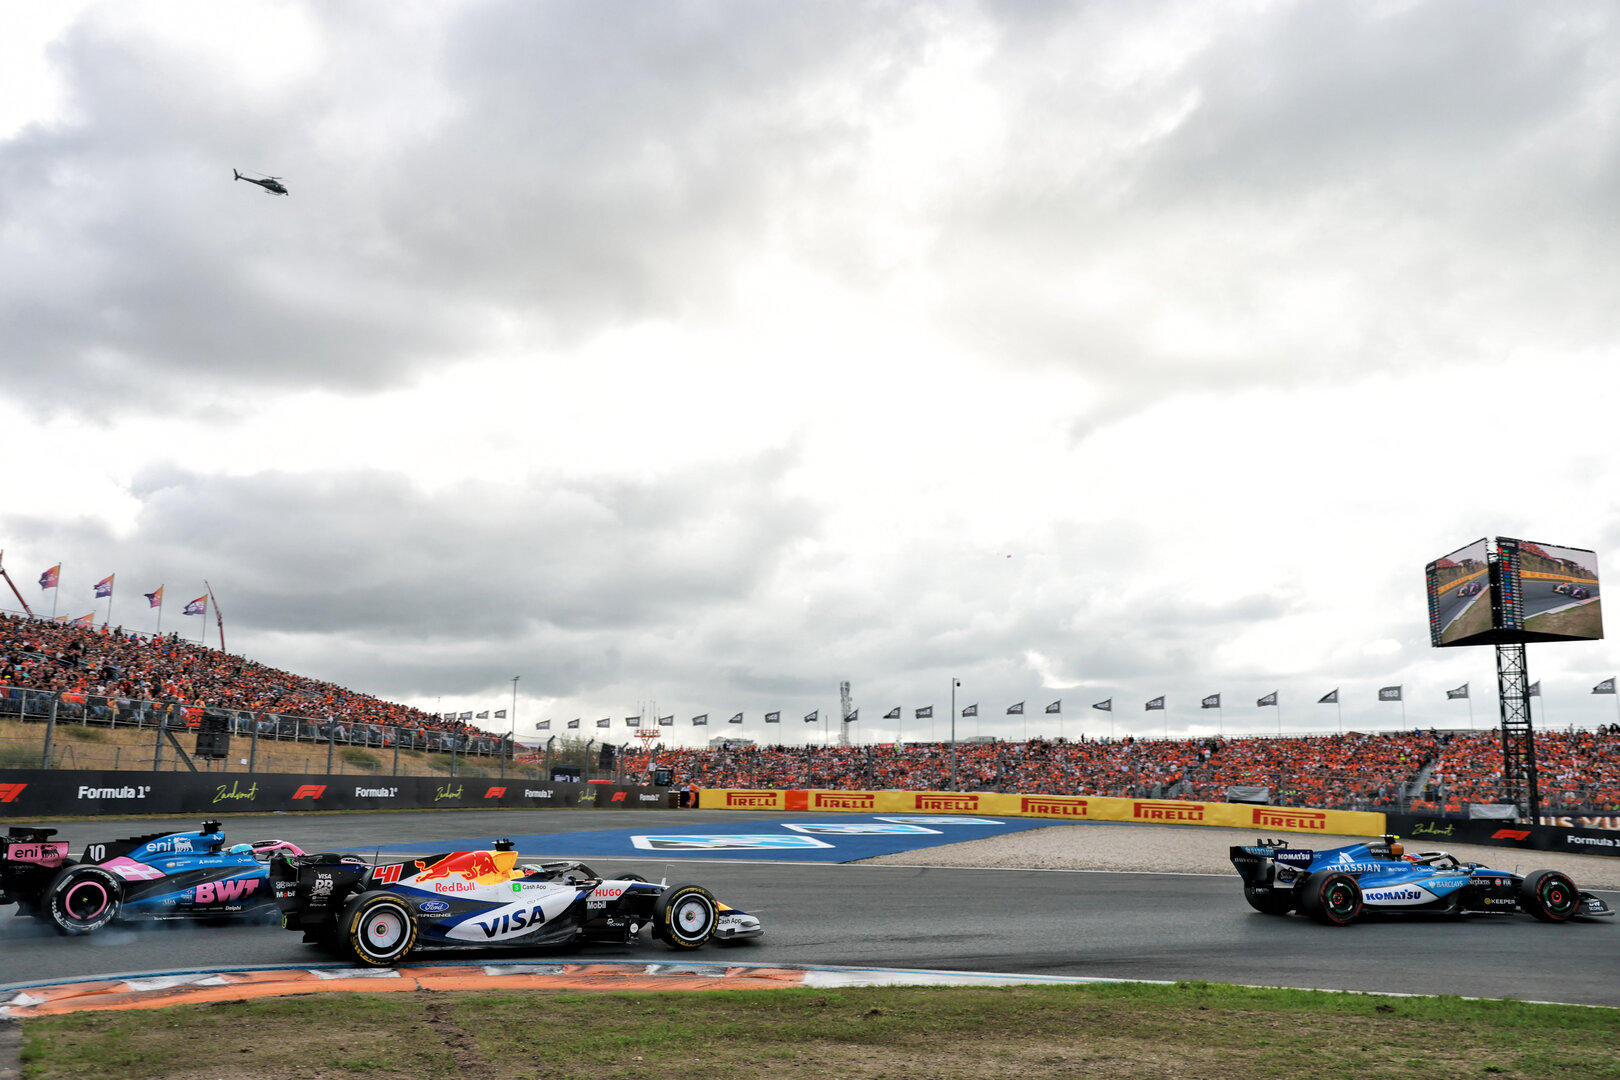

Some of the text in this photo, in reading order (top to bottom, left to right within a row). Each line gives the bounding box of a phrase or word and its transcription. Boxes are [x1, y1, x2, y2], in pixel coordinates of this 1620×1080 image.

[78, 786, 136, 800] Formula
[355, 787, 388, 798] Formula
[525, 789, 546, 798] Formula
[727, 792, 777, 806] PIRELLI
[816, 793, 874, 808] PIRELLI
[916, 795, 979, 811] PIRELLI
[1021, 797, 1087, 815] PIRELLI
[1133, 802, 1204, 820] PIRELLI
[1252, 808, 1326, 829] PIRELLI
[146, 841, 171, 852] eni
[1566, 834, 1614, 848] Formula
[14, 845, 39, 859] eni
[89, 844, 106, 862] 10
[1277, 852, 1311, 861] KOMATSU
[372, 863, 404, 885] 41
[1326, 863, 1381, 873] ATLASSIAN
[194, 878, 259, 904] BWT
[435, 882, 476, 893] Red Bull
[1437, 880, 1463, 888] BARCLAYS
[595, 888, 622, 897] HUGO
[1365, 889, 1422, 901] KOMATSU
[426, 902, 445, 910] Ford
[587, 901, 607, 909] Mobil
[473, 905, 546, 938] VISA
[731, 917, 743, 925] App
